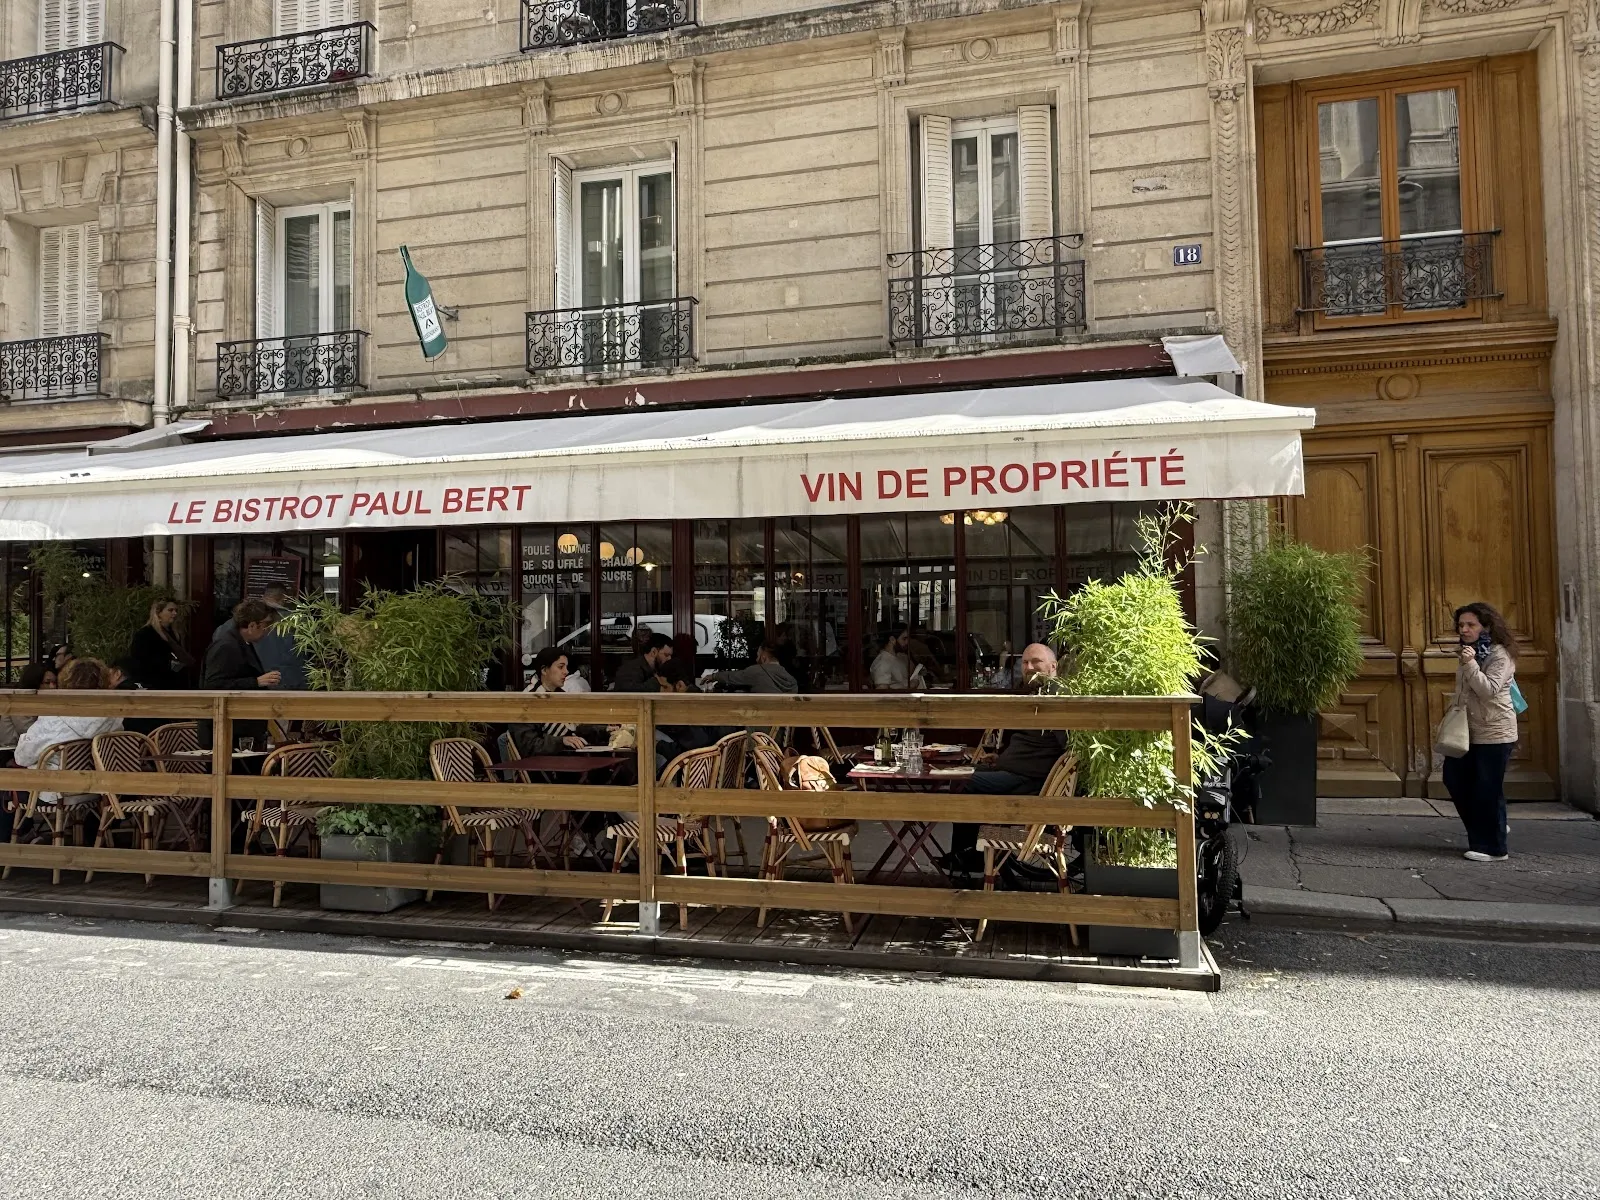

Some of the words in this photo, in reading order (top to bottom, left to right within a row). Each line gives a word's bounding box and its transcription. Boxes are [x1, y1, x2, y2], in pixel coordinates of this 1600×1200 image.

[1178, 247, 1198, 263] 18
[801, 471, 863, 502] VIN
[878, 468, 928, 500] DE
[944, 448, 1186, 495] PROPRIÉTÉ
[167, 500, 206, 524] LE
[212, 494, 344, 523] BISTROT
[349, 491, 431, 516] PAUL
[443, 486, 531, 513] BERT
[522, 545, 550, 556] FOULE
[559, 543, 591, 555] INTIME
[522, 560, 534, 571] DE
[541, 556, 584, 570] SOUFFLÉ
[600, 556, 634, 567] CHAUD
[522, 574, 562, 585] BOUCHE
[571, 572, 584, 583] DE
[600, 570, 633, 582] SUCRE
